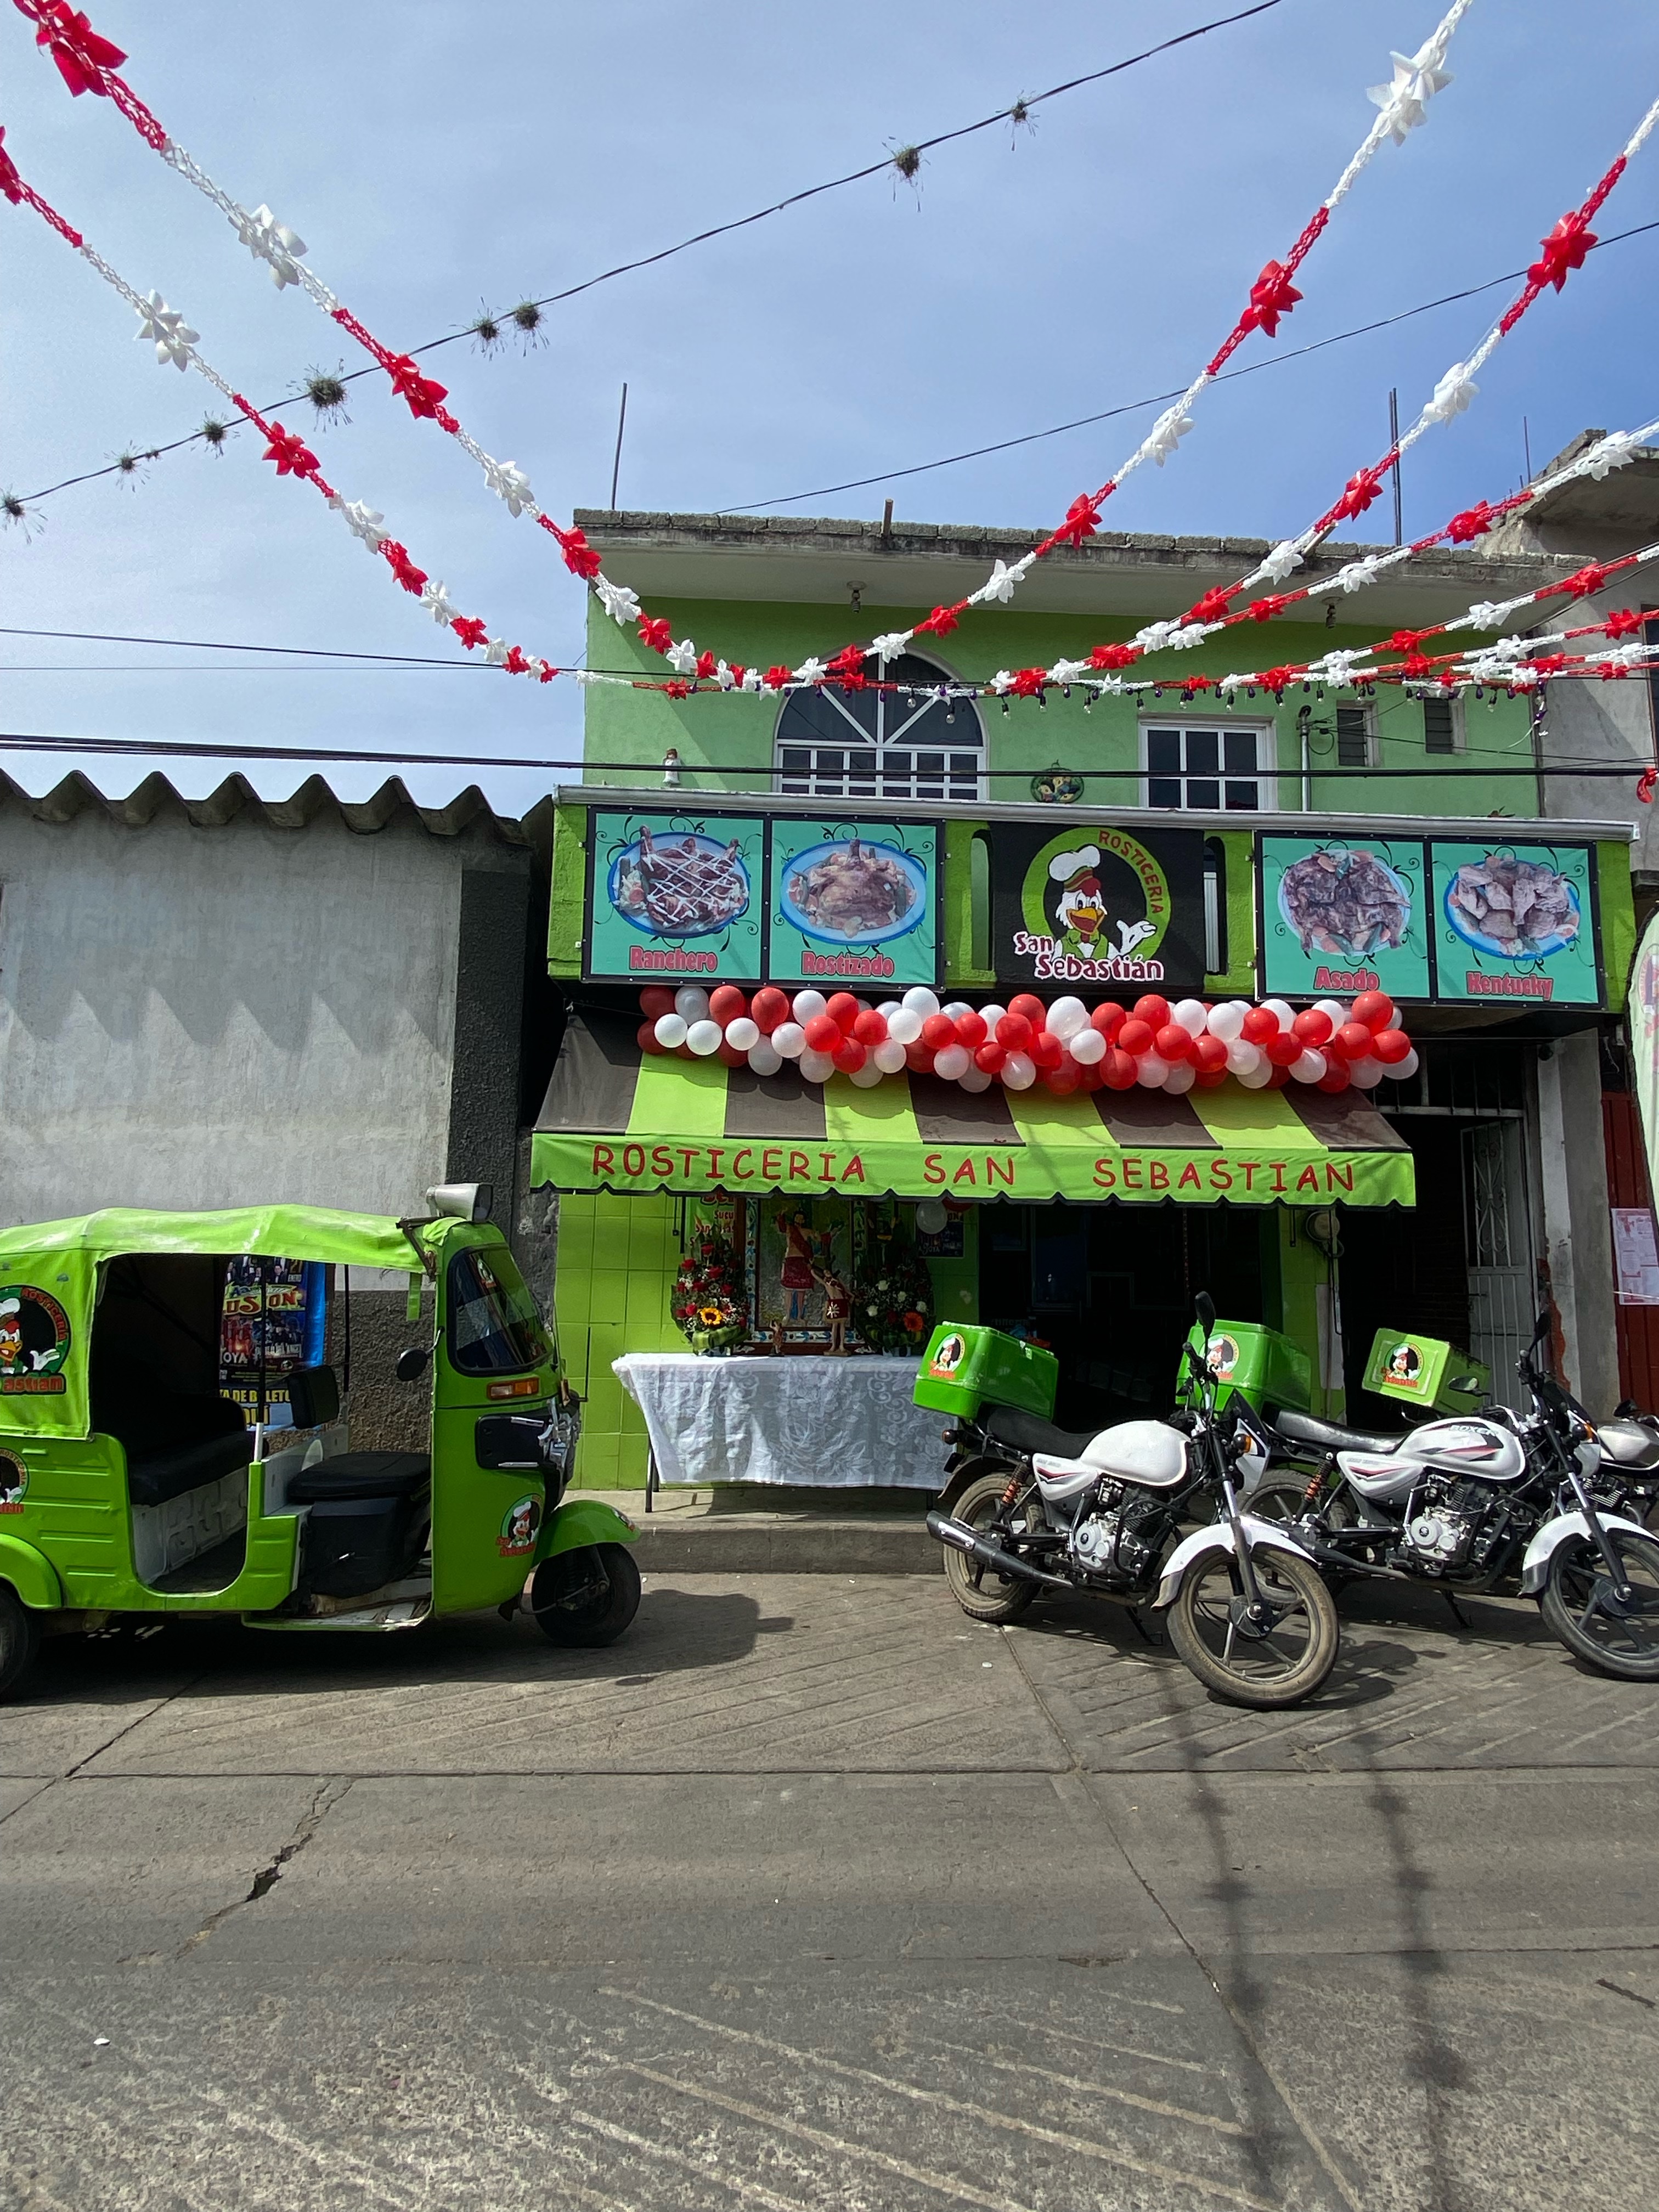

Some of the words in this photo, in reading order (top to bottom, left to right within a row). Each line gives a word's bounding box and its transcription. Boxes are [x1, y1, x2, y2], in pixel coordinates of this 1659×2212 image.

[1098, 830, 1164, 913] ROSTICERIA
[1014, 932, 1054, 955] San
[630, 945, 718, 972] Ranchero
[801, 951, 895, 978] Rostizado
[1035, 955, 1164, 981] Sebastián
[1314, 966, 1379, 991] Asado
[1466, 970, 1553, 1001] Kentucky
[592, 1143, 866, 1183] ROSTICERIA
[923, 1153, 1014, 1186] SAN
[1092, 1158, 1353, 1192] SEBASTIAN
